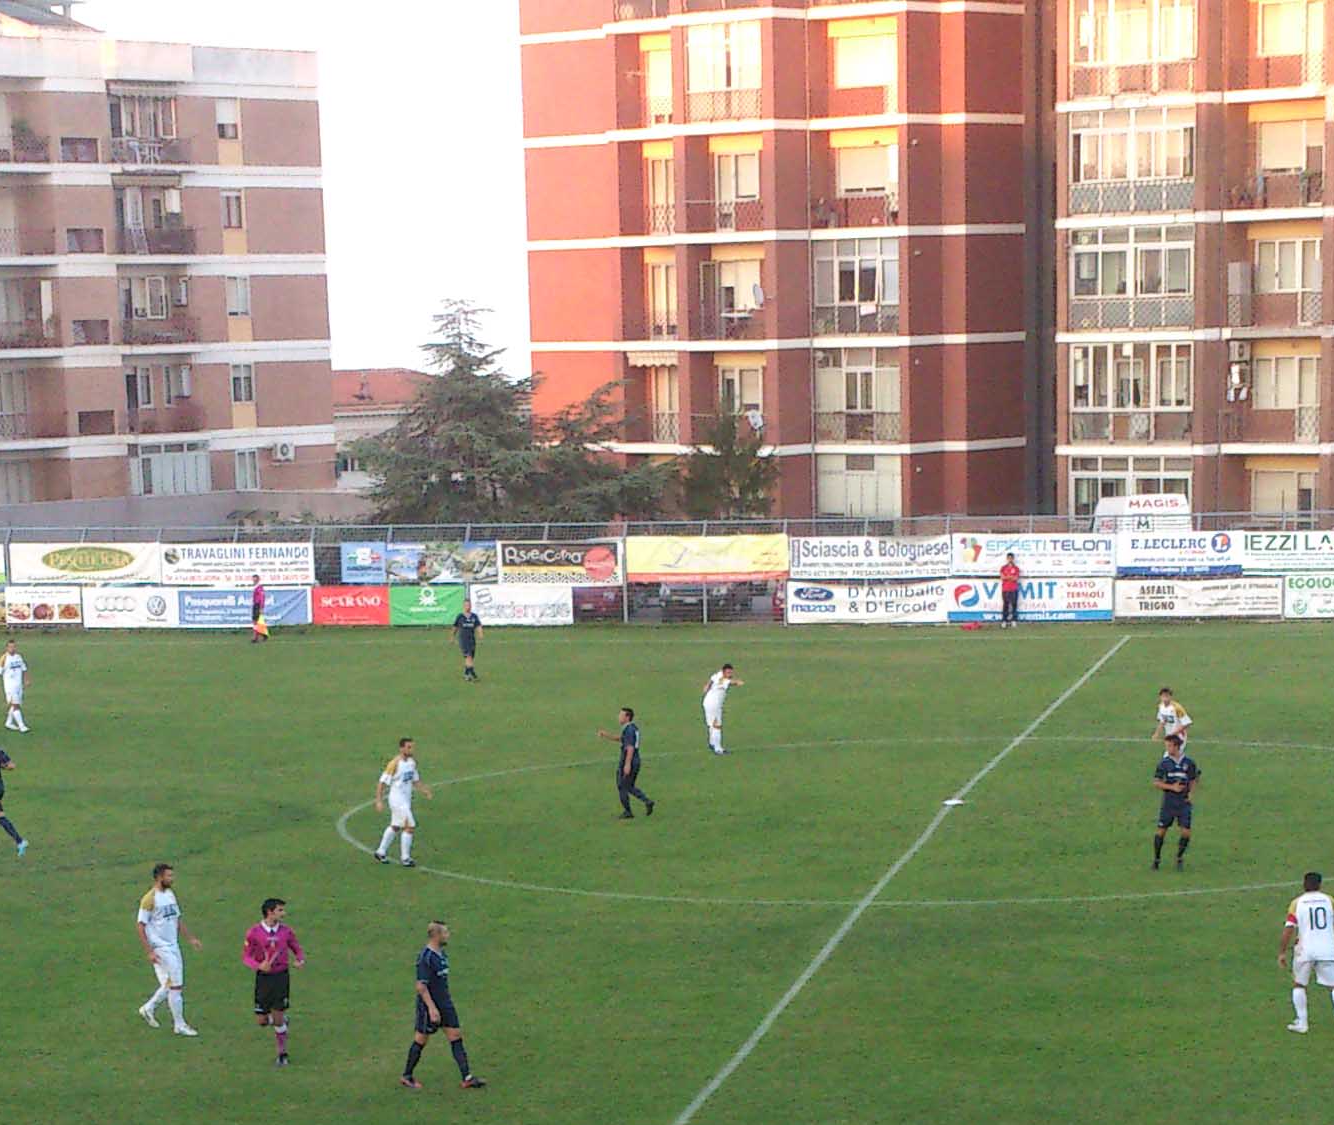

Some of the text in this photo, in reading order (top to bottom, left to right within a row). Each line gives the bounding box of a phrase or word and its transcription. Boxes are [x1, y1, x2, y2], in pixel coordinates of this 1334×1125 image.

[1244, 533, 1297, 551] IEZZI
[181, 546, 309, 559] TRAVAGLINI FERNANDO
[802, 540, 948, 560] Sciascia & Bolognese
[983, 582, 1057, 600] VMIT
[1140, 586, 1175, 595] ASFALTI
[849, 602, 860, 613] &
[1140, 601, 1175, 610] TRIGNO
[1309, 906, 1328, 930] 10
